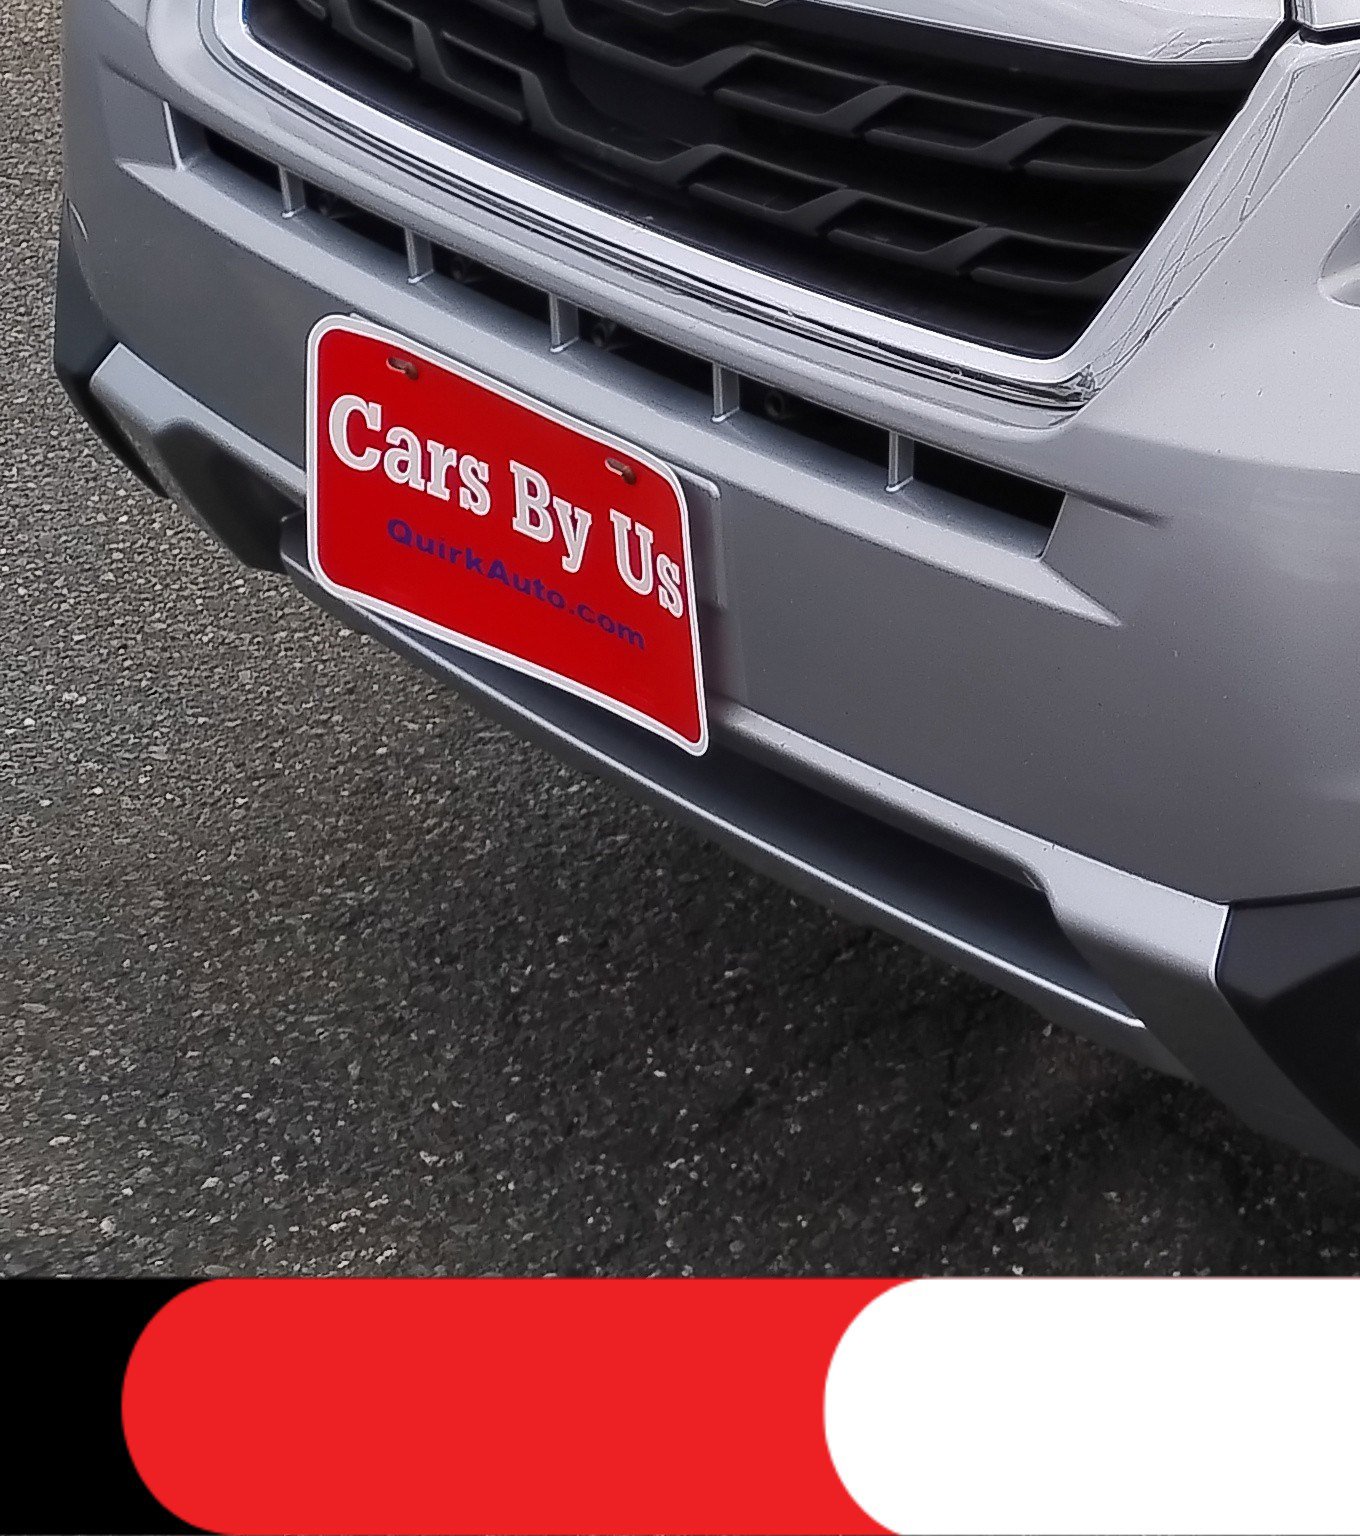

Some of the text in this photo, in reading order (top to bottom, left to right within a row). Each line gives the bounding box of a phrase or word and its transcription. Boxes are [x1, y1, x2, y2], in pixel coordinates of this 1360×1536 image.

[328, 394, 684, 618] Cars By Us
[387, 518, 646, 651] QuirkAuto.com
